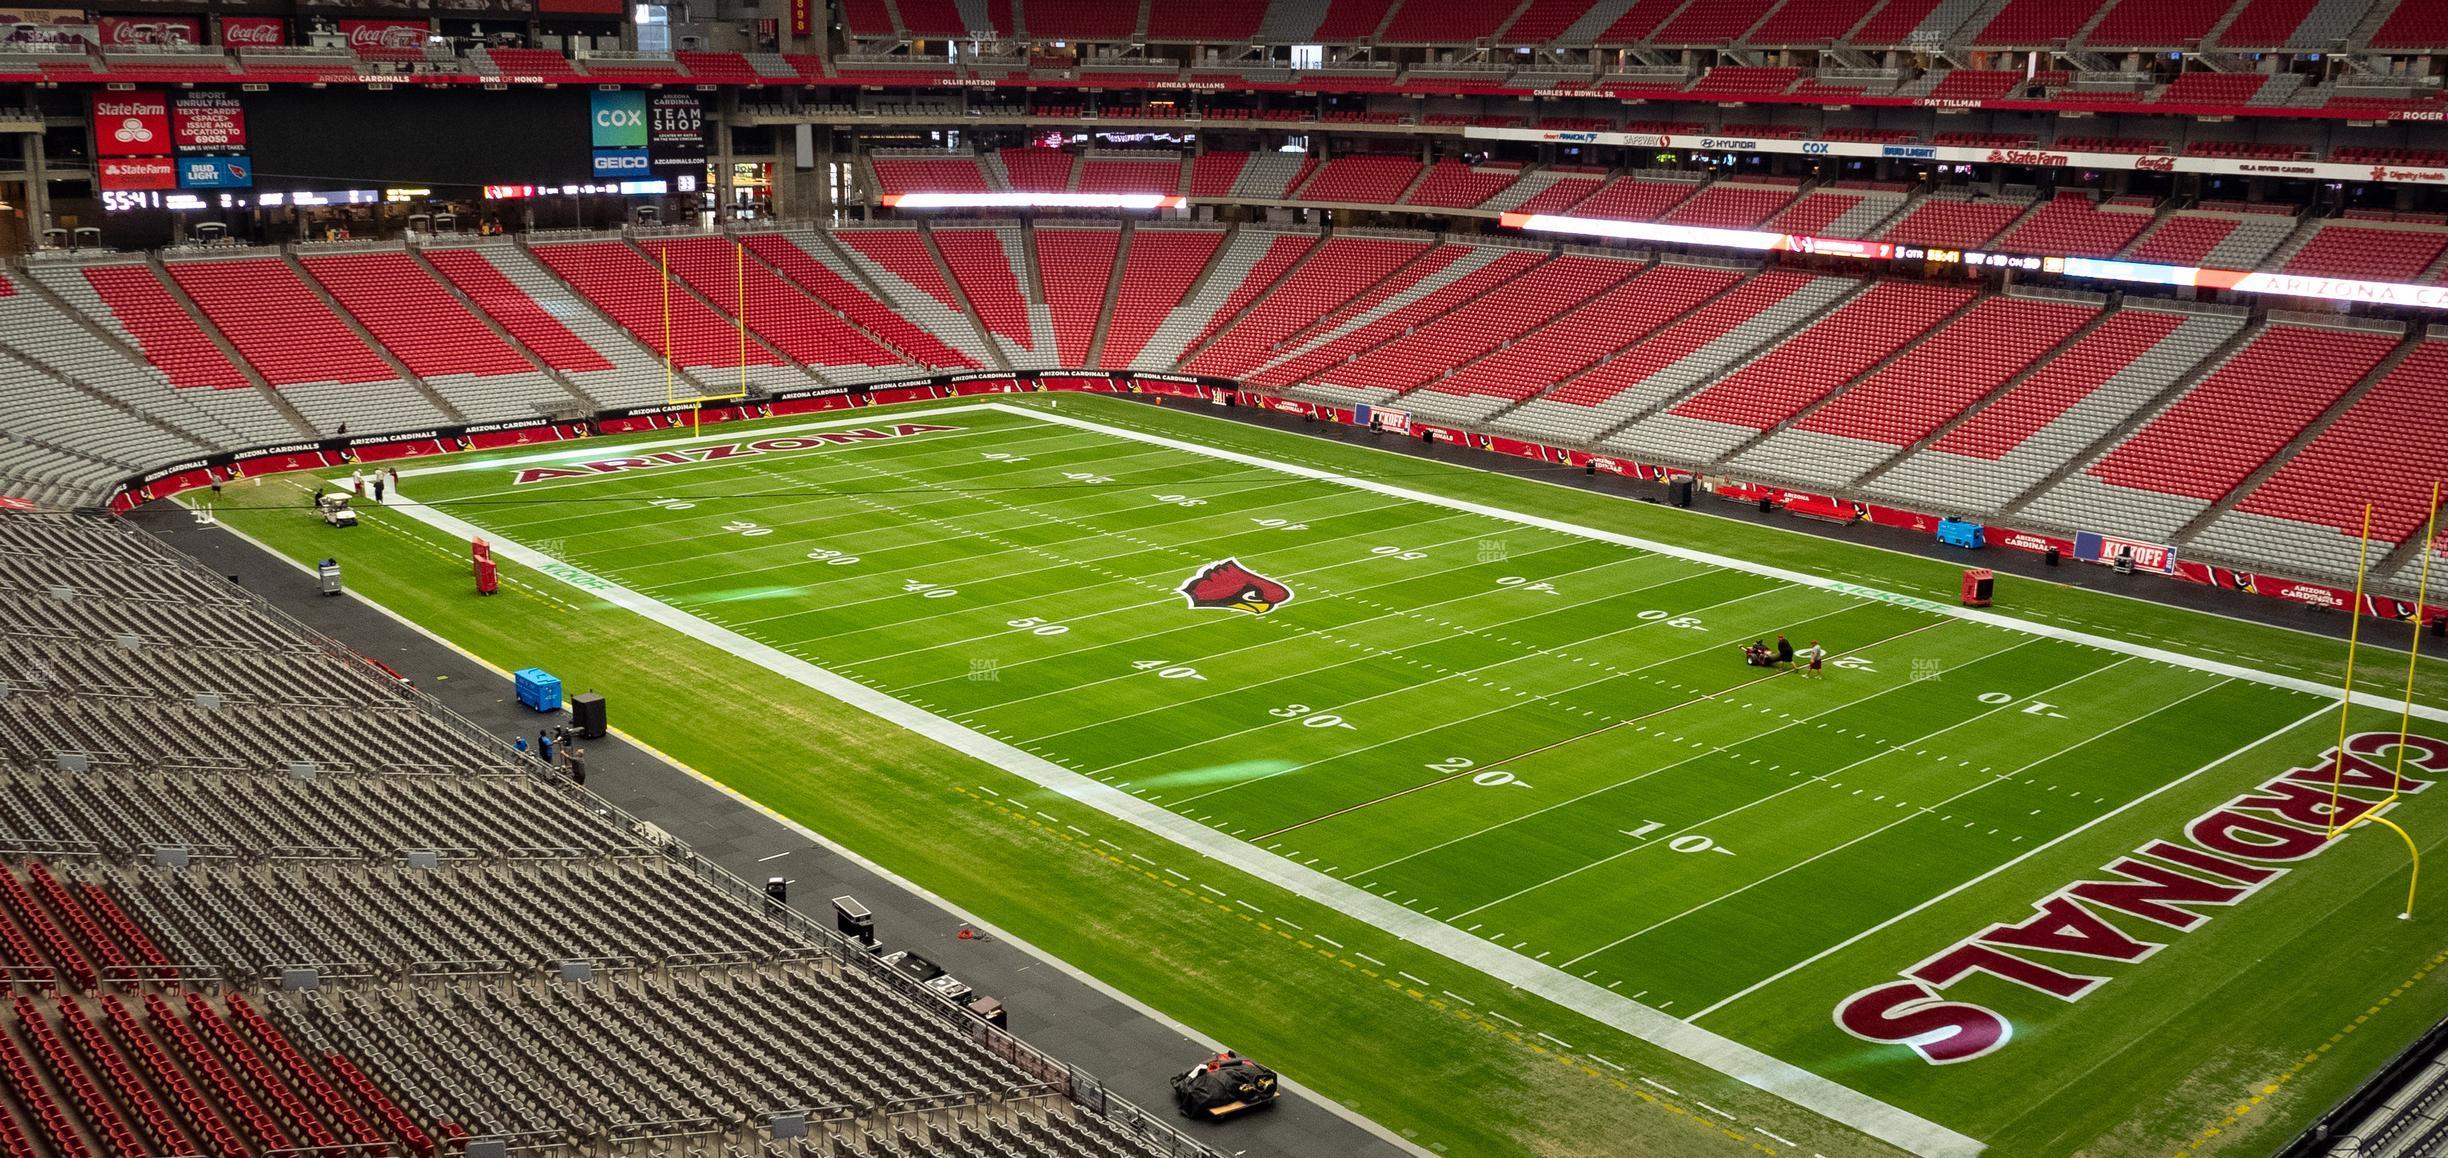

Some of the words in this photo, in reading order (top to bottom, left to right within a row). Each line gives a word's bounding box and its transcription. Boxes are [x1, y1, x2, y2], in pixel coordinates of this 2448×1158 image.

[359, 75, 410, 83] CARDINALS
[1188, 82, 1225, 90] WILLIAMS
[188, 91, 226, 99] REPORT
[176, 99, 213, 107] UNRULY
[216, 99, 240, 107] FANS
[1924, 99, 1941, 107] PAT
[1942, 99, 1982, 108] TILLMAN
[597, 109, 642, 127] COX
[653, 108, 701, 119] TEAM
[2388, 111, 2400, 120] 22
[2403, 111, 2445, 120] ROGER
[187, 121, 212, 129] ISSUE
[654, 119, 701, 130] SHOP
[181, 128, 226, 136] LOCATION
[228, 128, 241, 136] TO
[195, 135, 228, 143] 69050
[1623, 135, 1660, 146] SAFEWAY
[1715, 141, 1756, 149] HYUNDAI
[1802, 143, 1829, 154] COX
[1884, 147, 1904, 156] BUD
[1905, 148, 1935, 158] LIGHT
[191, 164, 214, 172] BUD
[594, 156, 648, 169] GEICO
[2239, 164, 2257, 172] GILA
[2258, 165, 2280, 173] RIVER
[2281, 166, 2315, 174] CASINOS
[188, 171, 220, 180] LIGHT
[2390, 170, 2418, 181] Dignity
[2419, 171, 2446, 180] Health
[2265, 276, 2396, 301] ARIZONA
[951, 374, 978, 382] ARIZONA
[979, 372, 1017, 380] CARDINALS
[1133, 372, 1162, 380] ARIZONA
[1162, 374, 1198, 383] CARDINALS
[869, 382, 897, 391] ARIZONA
[898, 379, 932, 388] CARDINALS
[782, 391, 812, 400] ARIZONA
[812, 387, 849, 398] CARDINALS
[628, 406, 661, 416] ARIZONA
[465, 424, 501, 434] ARIZONA
[502, 418, 548, 430] CARDINALS
[350, 436, 389, 446] ARIZONA
[390, 430, 438, 442] CARDINALS
[234, 448, 268, 461] ARIZONA
[269, 442, 320, 455] CARDINALS
[513, 421, 970, 487] ARIZONA
[1783, 491, 1810, 502] ARIZONA
[2015, 534, 2046, 545] ARIZONA
[806, 549, 861, 565] 30
[1370, 546, 1428, 561] 50
[902, 583, 958, 598] 40
[2293, 585, 2332, 597] ARIZONA
[1828, 583, 1952, 612] KICKOFF
[1637, 609, 1703, 628] 30
[1007, 616, 1070, 636] 50
[1131, 660, 1197, 679] 40
[1268, 703, 1343, 729] 30
[1424, 756, 1516, 787] 20
[1618, 818, 1714, 854] 10
[1832, 732, 2448, 1066] CARDINALS
